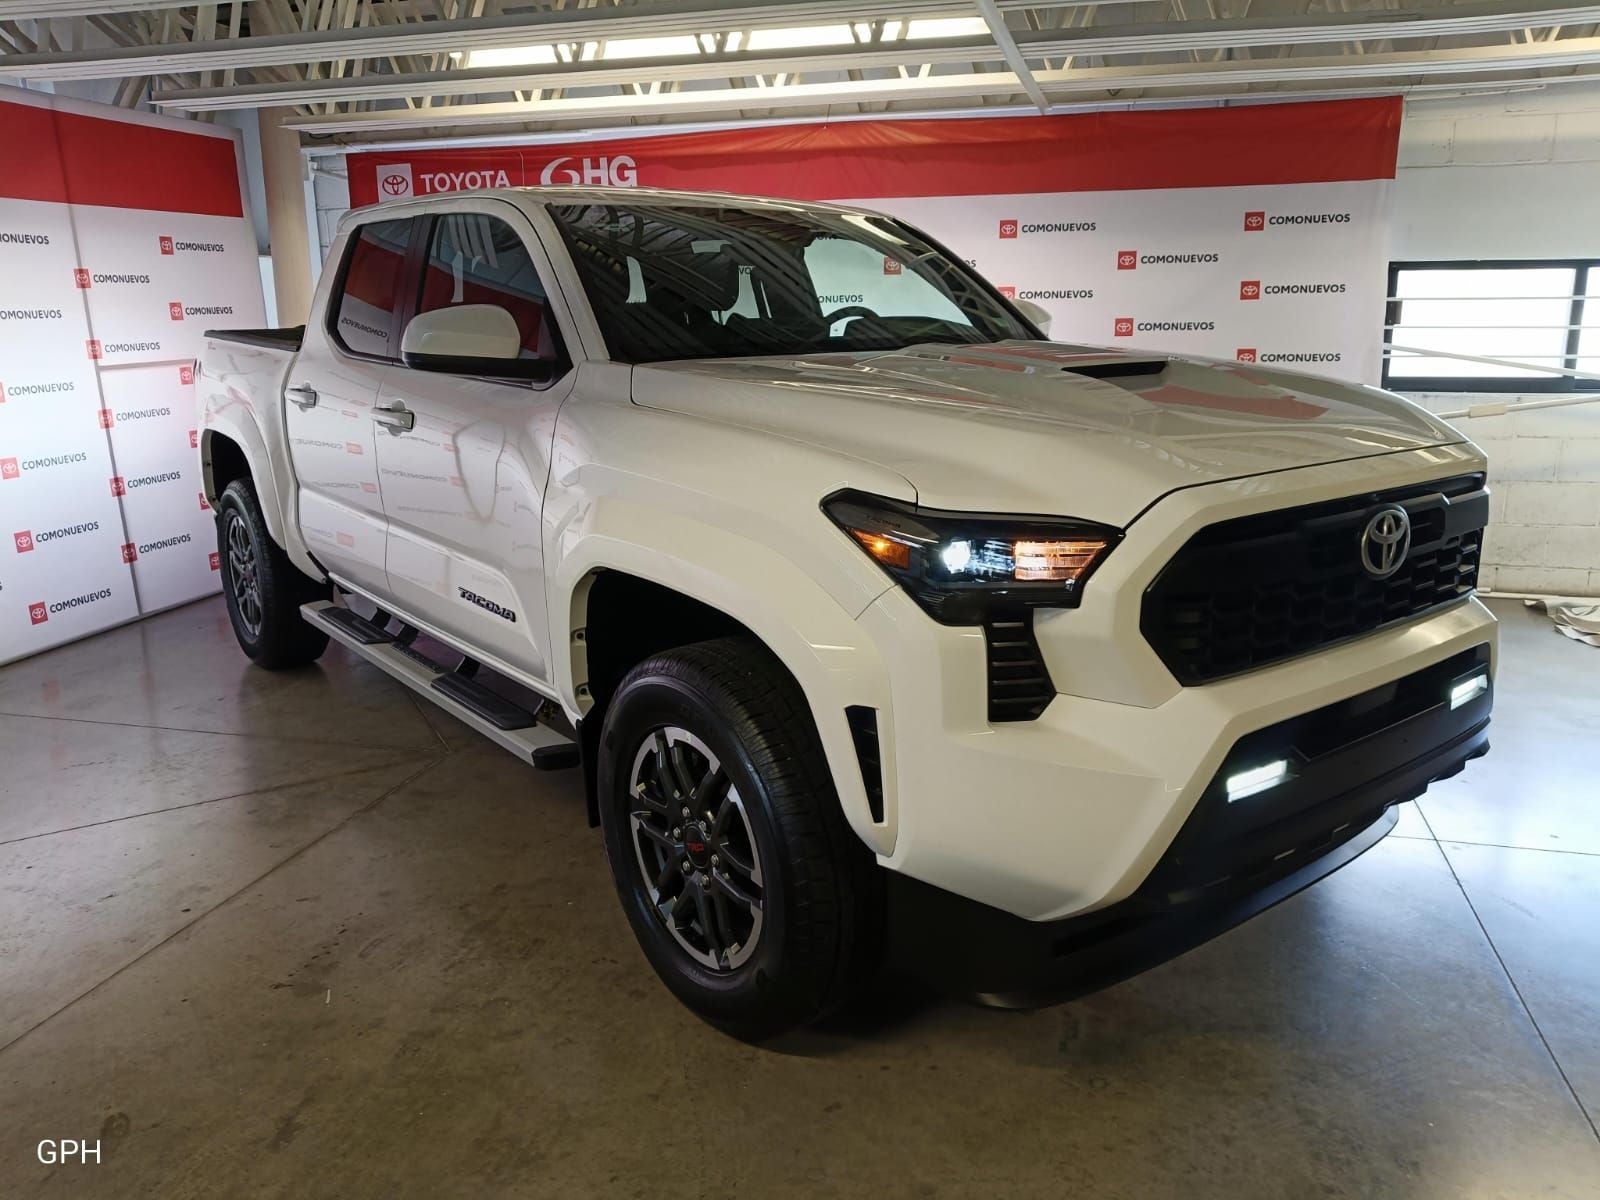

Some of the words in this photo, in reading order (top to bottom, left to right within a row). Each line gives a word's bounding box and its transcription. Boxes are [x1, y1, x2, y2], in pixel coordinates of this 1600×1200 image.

[420, 169, 511, 193] TOYOTA
[1268, 213, 1351, 226] COMONUEVOS
[1021, 221, 1097, 234] COMONUEVOS
[175, 241, 225, 253] COMONUEVOS
[1140, 253, 1219, 265] COMONUEVOS
[93, 273, 151, 284] COMONUEVOS
[1018, 289, 1094, 300] COMONUEVOS
[1264, 283, 1346, 295] COMONUEVOS
[818, 294, 864, 304] ONUEVOS
[0, 309, 63, 320] OMONUEVOS
[185, 306, 233, 316] COMONUEVOS
[1137, 321, 1215, 332] COMONUEVOS
[104, 341, 161, 353] COMONUEVOS
[1260, 352, 1341, 363] COMONUEVOS
[8, 381, 75, 397] COMONUEVOS
[116, 407, 171, 422] COMONUEVOS
[21, 452, 87, 471] COMONUEVOS
[127, 470, 181, 489] COMONUEVOS
[35, 520, 100, 544] COMONUEVOS
[138, 533, 192, 554] COMONUEVOS
[49, 587, 112, 614] COMONUEVOS
[457, 586, 517, 623] TACOMA
